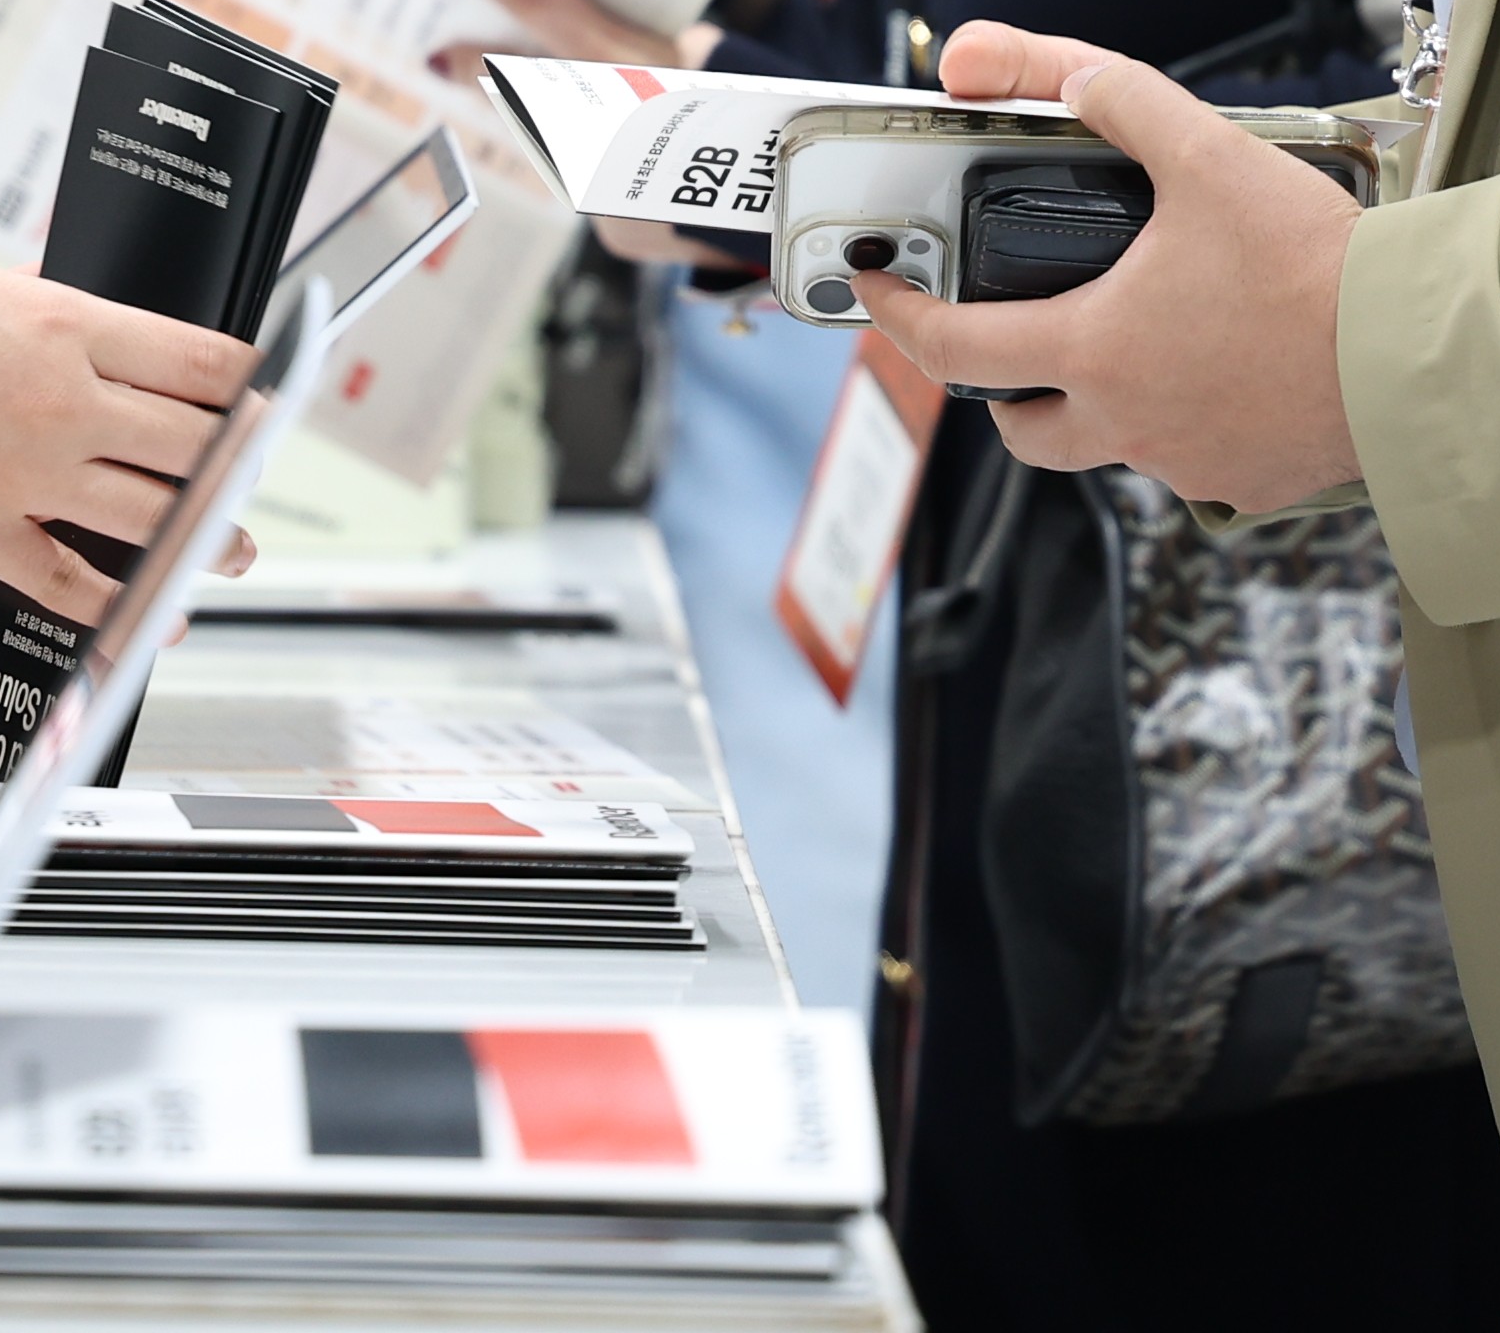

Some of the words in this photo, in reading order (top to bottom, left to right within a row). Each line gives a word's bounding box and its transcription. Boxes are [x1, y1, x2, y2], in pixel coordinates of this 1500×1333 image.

[139, 98, 211, 142] Remember
[626, 178, 648, 200] 국내
[638, 158, 658, 178] 최초
[649, 136, 670, 155] B2B
[660, 113, 684, 134] 리서치
[670, 146, 739, 207] B2B
[14, 609, 28, 626] 공식
[27, 615, 41, 632] 성장
[40, 622, 53, 637] B2B
